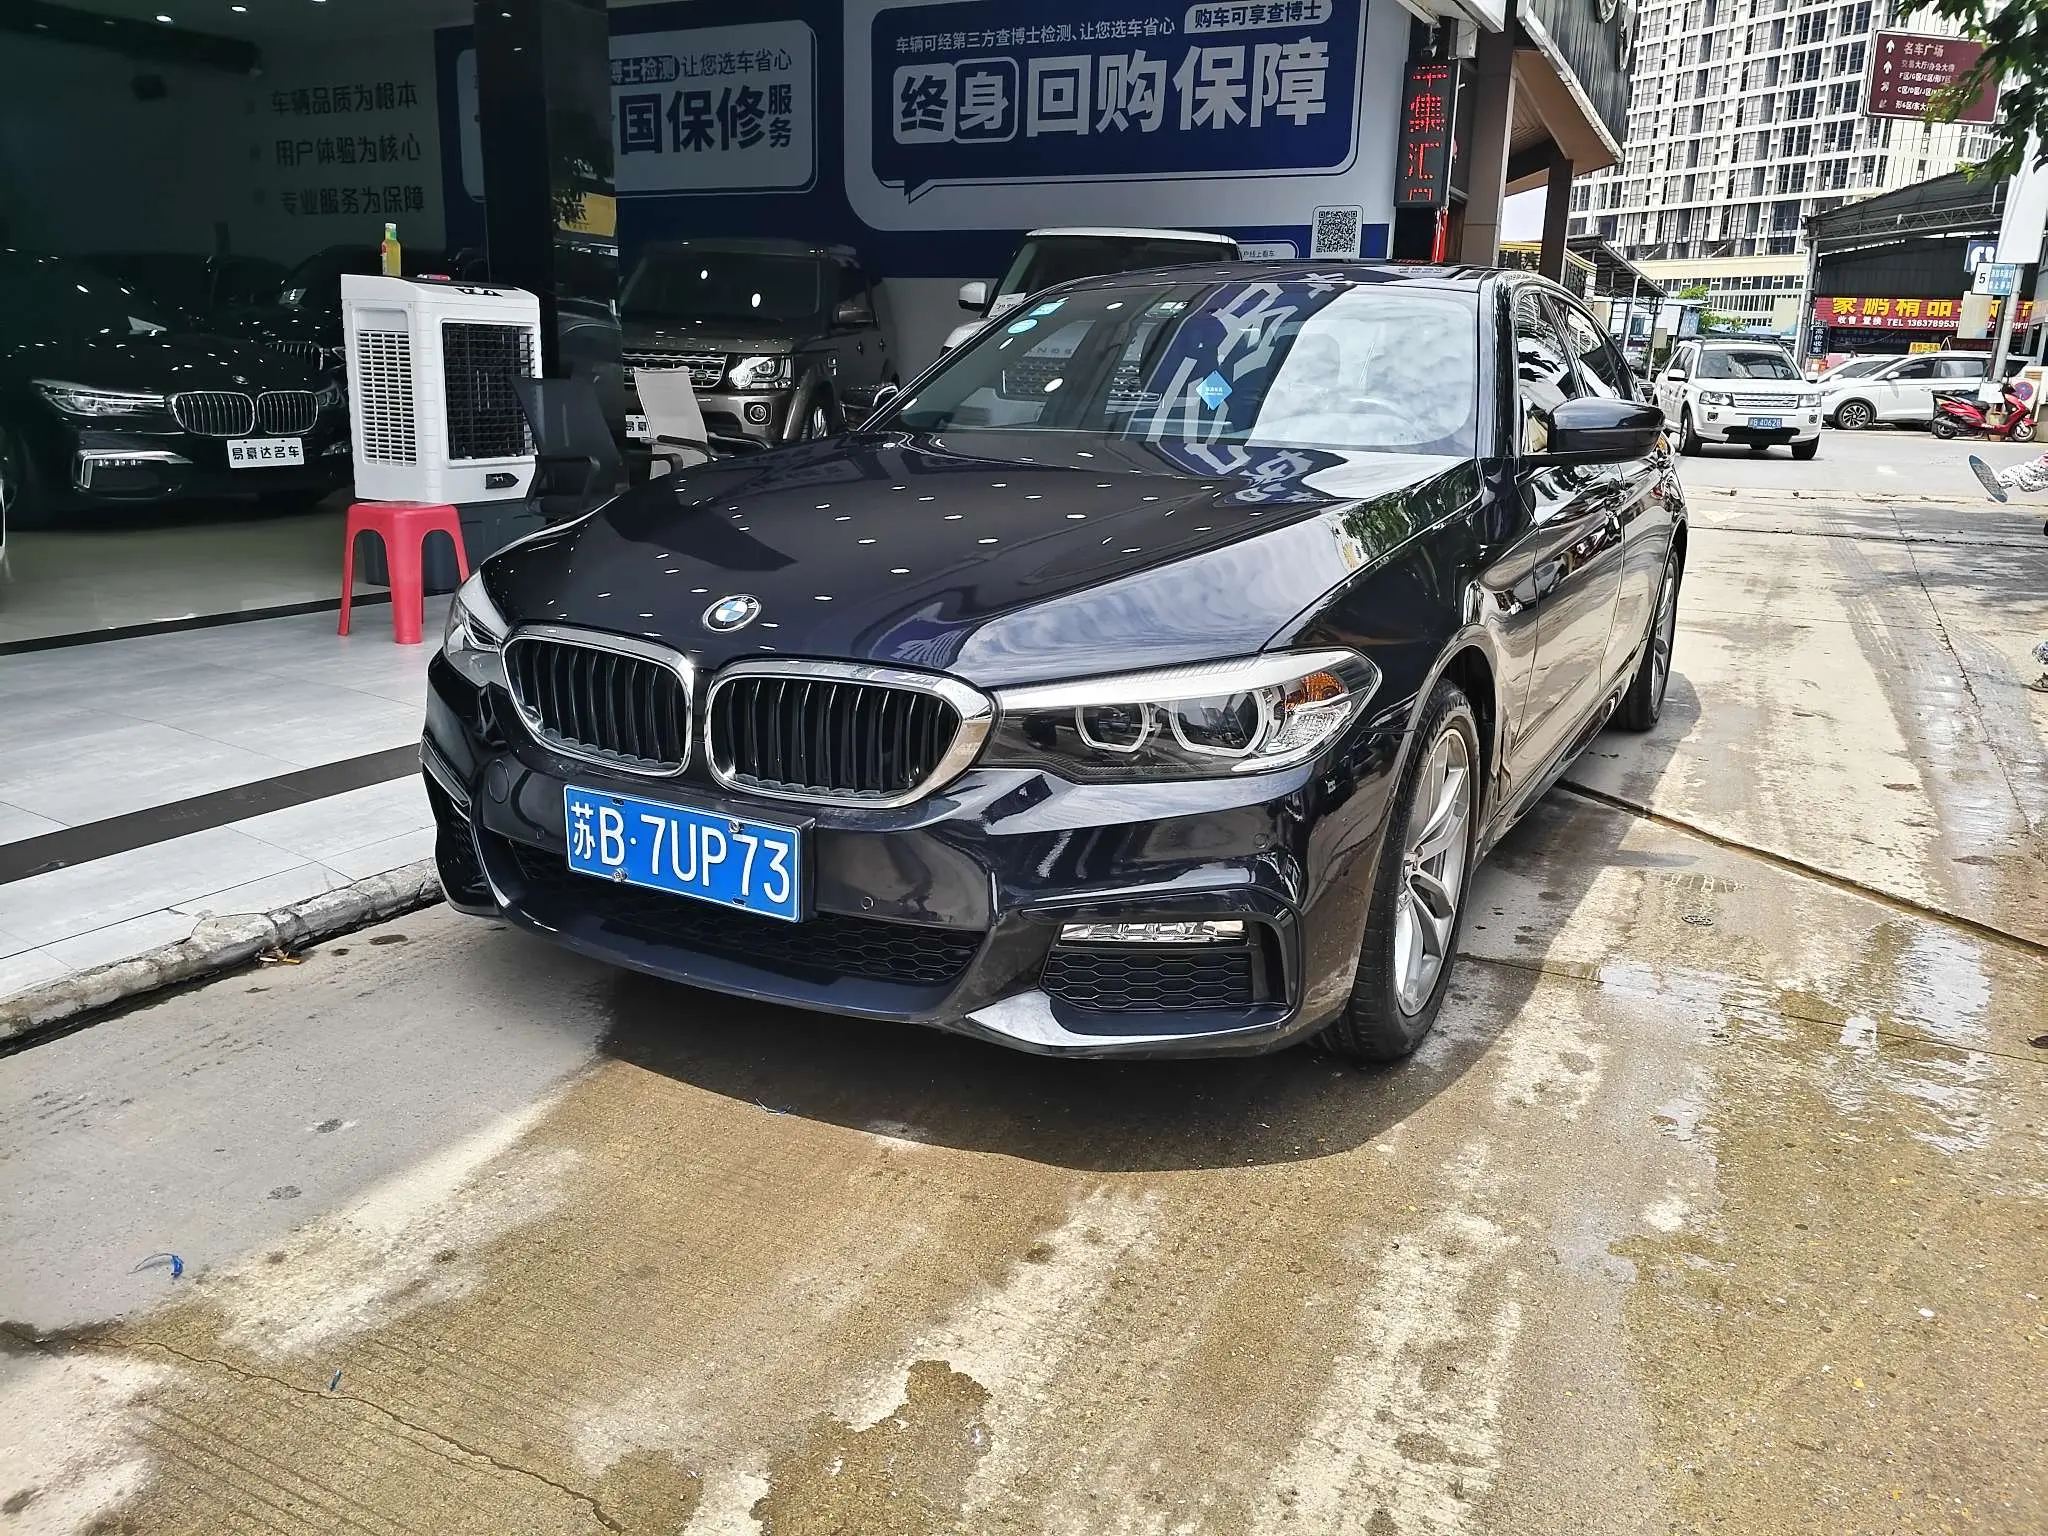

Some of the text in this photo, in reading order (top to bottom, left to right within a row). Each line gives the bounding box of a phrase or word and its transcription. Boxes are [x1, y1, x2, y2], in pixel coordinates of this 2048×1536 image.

[1194, 0, 1322, 28] 购车可享查博士
[896, 17, 1175, 53] 车辆可经第三方查博士检测、让您选车省心
[1903, 42, 1945, 57] 名车广场
[681, 49, 792, 78] 让您选车省心
[270, 81, 418, 116] 车辆品质为根本
[900, 36, 1329, 137] 终身回购保障
[275, 132, 421, 167] 用户体验为核心
[281, 185, 425, 216] 专业服务为保障
[1978, 272, 1988, 285] 5
[1886, 318, 1904, 327] TEL
[1907, 319, 1960, 328] 1363789531
[232, 445, 300, 461] 易豪达名车
